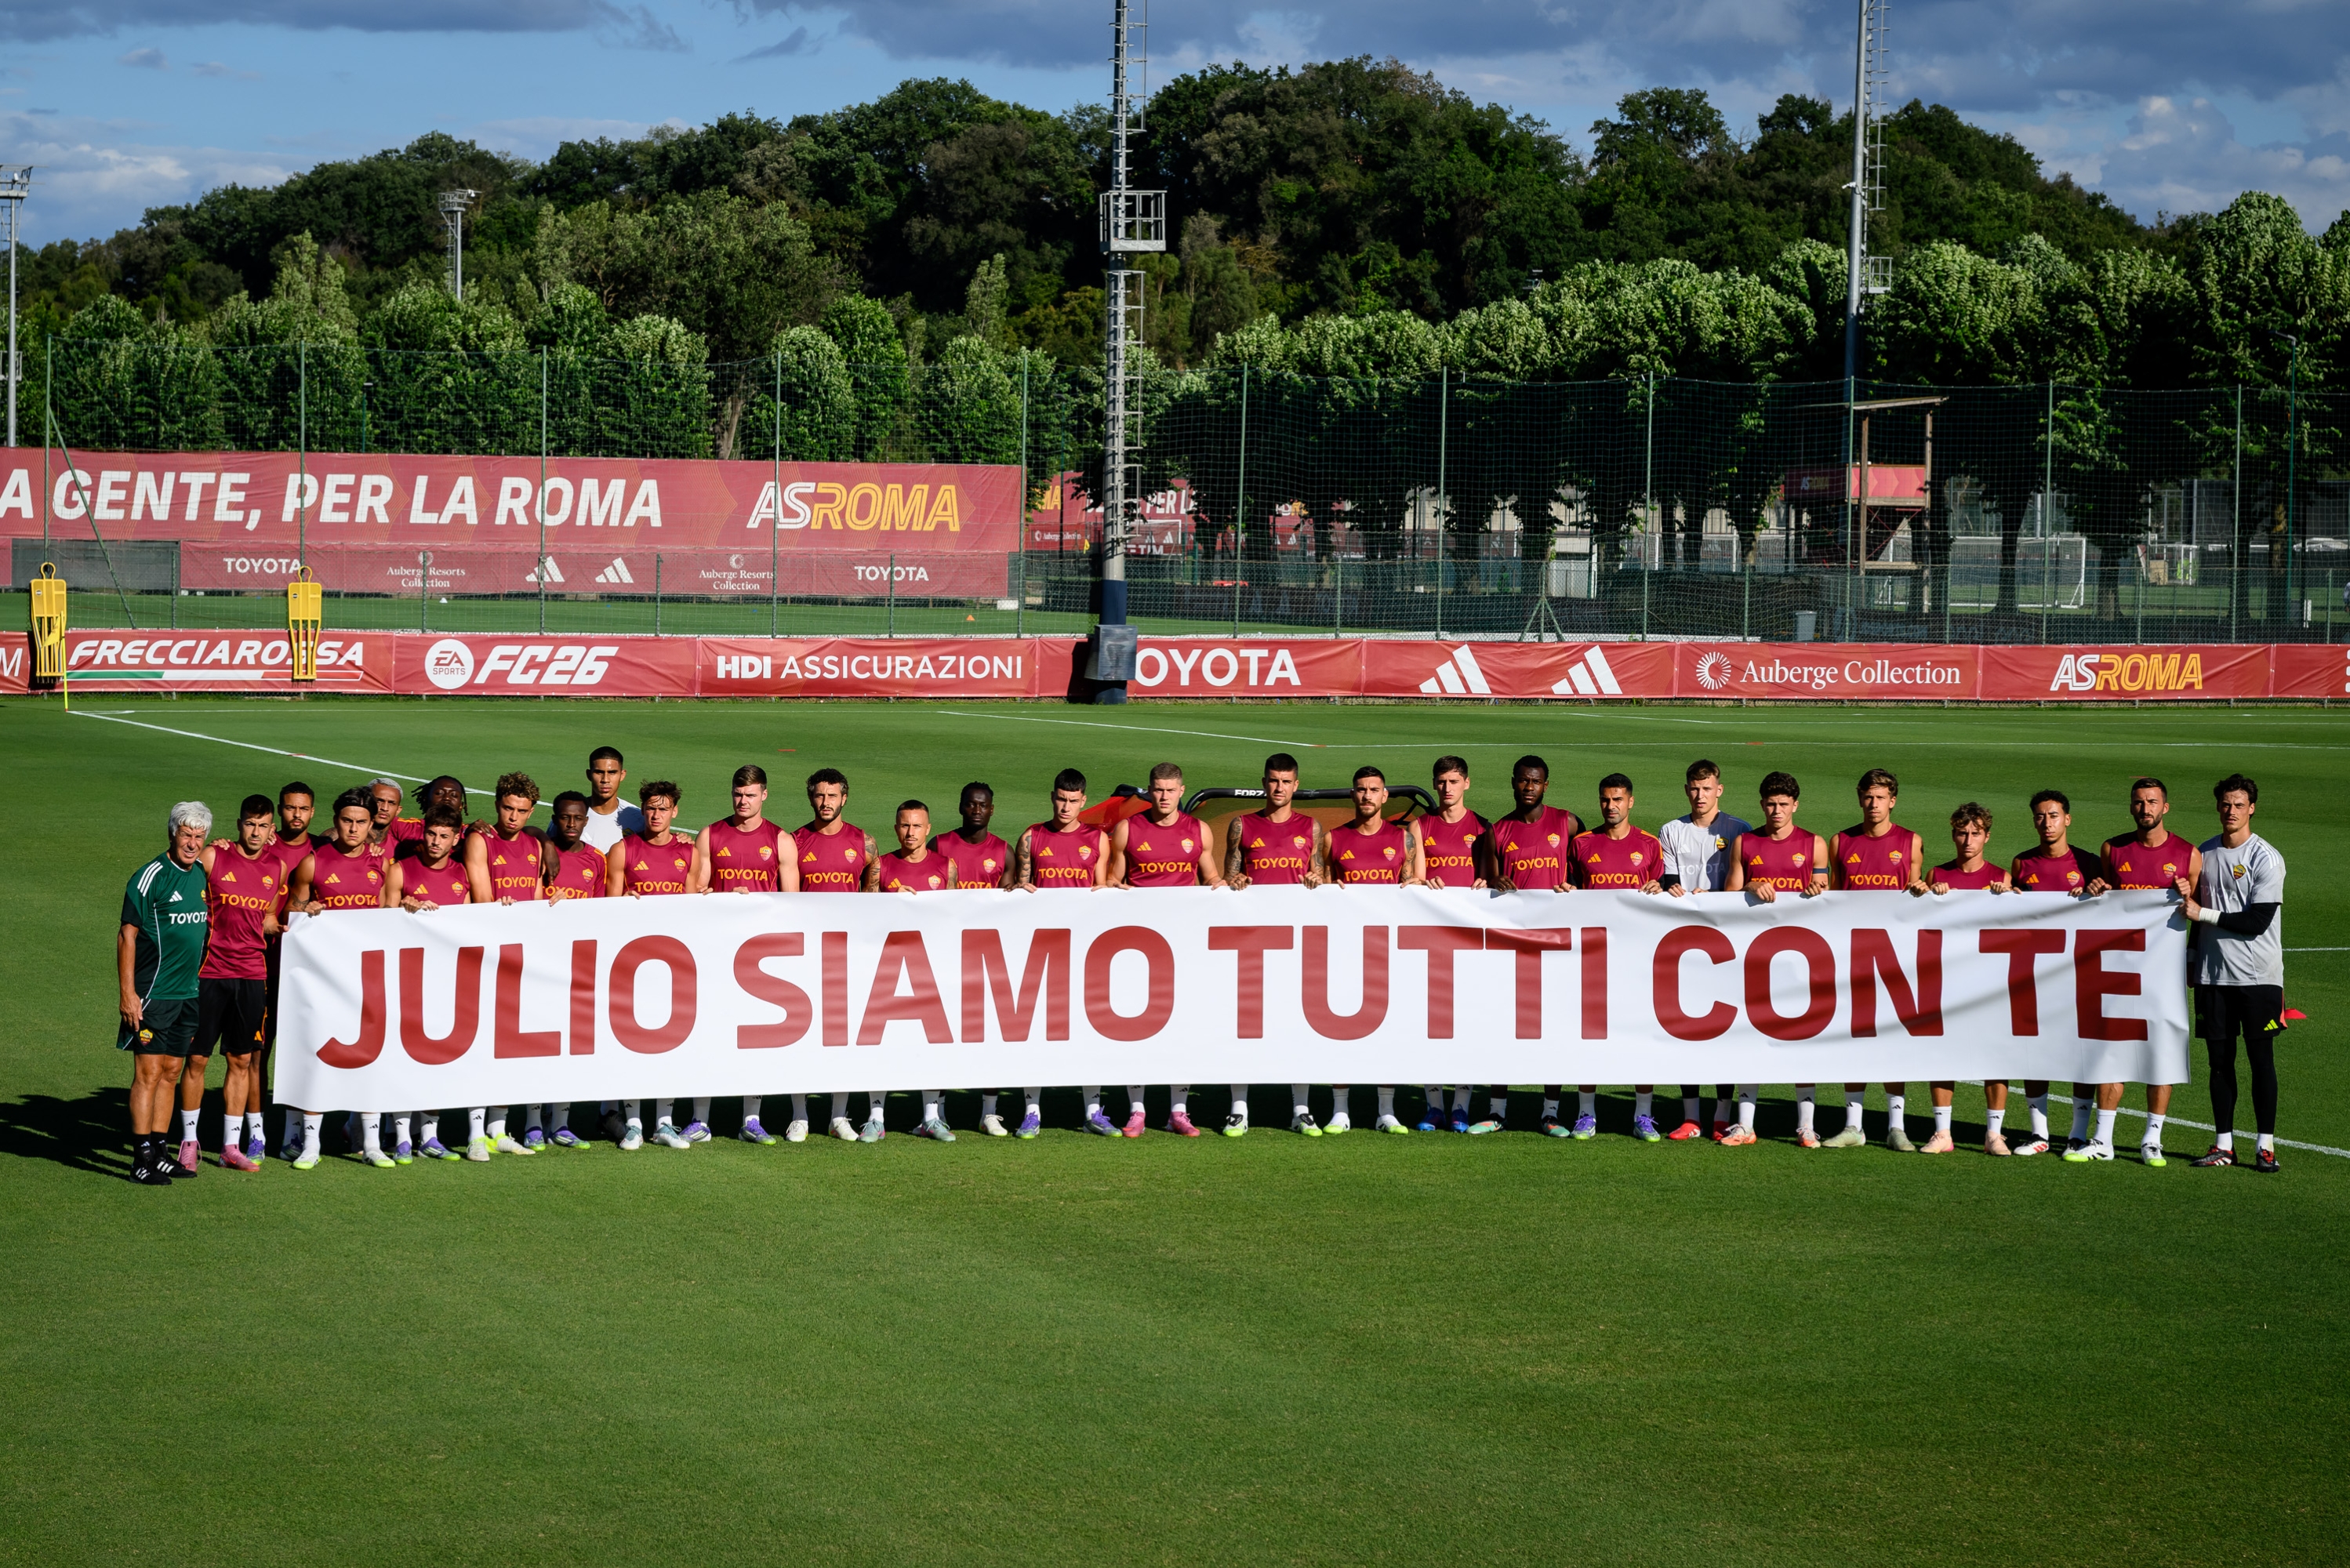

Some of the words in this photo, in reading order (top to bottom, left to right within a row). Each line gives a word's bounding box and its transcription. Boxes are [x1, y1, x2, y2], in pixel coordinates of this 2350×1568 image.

[53, 469, 260, 532] GENTE,
[282, 473, 394, 524] PER
[409, 475, 478, 524] LA
[494, 477, 662, 527] ROMA
[223, 557, 301, 574] TOYOTA
[387, 566, 426, 578] Auberg
[429, 567, 466, 576] Resorts
[699, 569, 738, 581] Auberge
[854, 565, 930, 581] TOYOTA
[713, 580, 760, 590] Collection
[434, 650, 465, 666] EA
[717, 655, 772, 679] HDI
[780, 655, 1022, 679] ASSICURAZIONI
[1135, 648, 1302, 687] OYOTA
[1739, 659, 1839, 690] Auberge
[1844, 659, 1961, 684] Collection
[1139, 862, 1193, 873] TOYOTA
[1252, 857, 1303, 869] TOYOTA
[1425, 855, 1474, 868] TOYOTA
[1511, 857, 1559, 871] OYOTA
[717, 868, 768, 881] TOYOTA
[805, 872, 854, 884] TOYOTA
[1038, 867, 1088, 880] TOYOTA
[1345, 869, 1394, 882] TOYOTA
[1590, 873, 1640, 885] TOYOTA
[495, 876, 536, 889] TOYOTA
[634, 880, 683, 894] TOYOTA
[957, 880, 992, 890] YOTA
[1849, 874, 1899, 887] TOYOTA
[542, 885, 588, 899] OOTA
[325, 894, 378, 908] TOYOTA
[315, 935, 697, 1069] JULIO
[732, 925, 1175, 1049] SIAMO
[1208, 925, 1607, 1040] TUTTI
[1652, 925, 1942, 1041] CON
[1978, 928, 2148, 1041] TE
